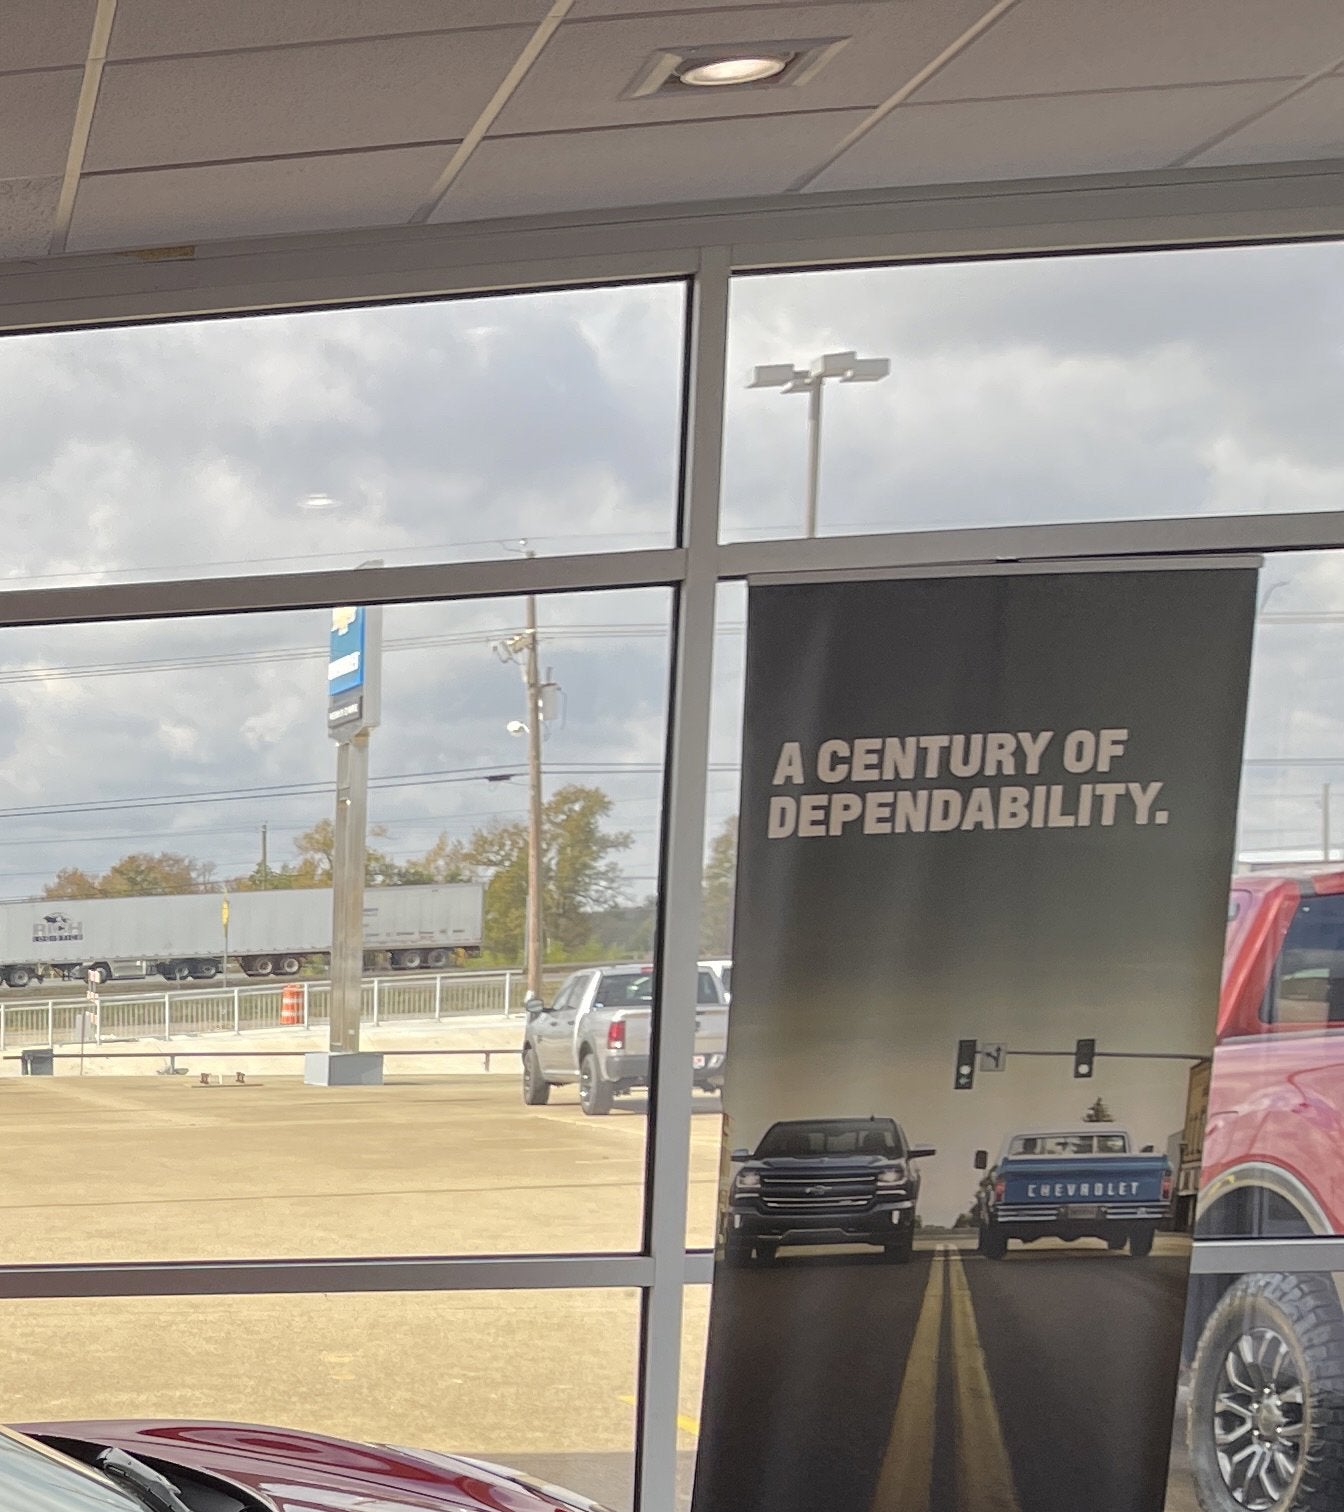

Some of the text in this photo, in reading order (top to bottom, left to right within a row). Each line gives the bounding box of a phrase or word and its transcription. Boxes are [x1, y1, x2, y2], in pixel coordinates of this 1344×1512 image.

[772, 728, 1130, 786] A CENTURY OF
[766, 780, 1171, 840] DEPENDABILITY.
[1027, 1182, 1140, 1197] CHEVROLET
